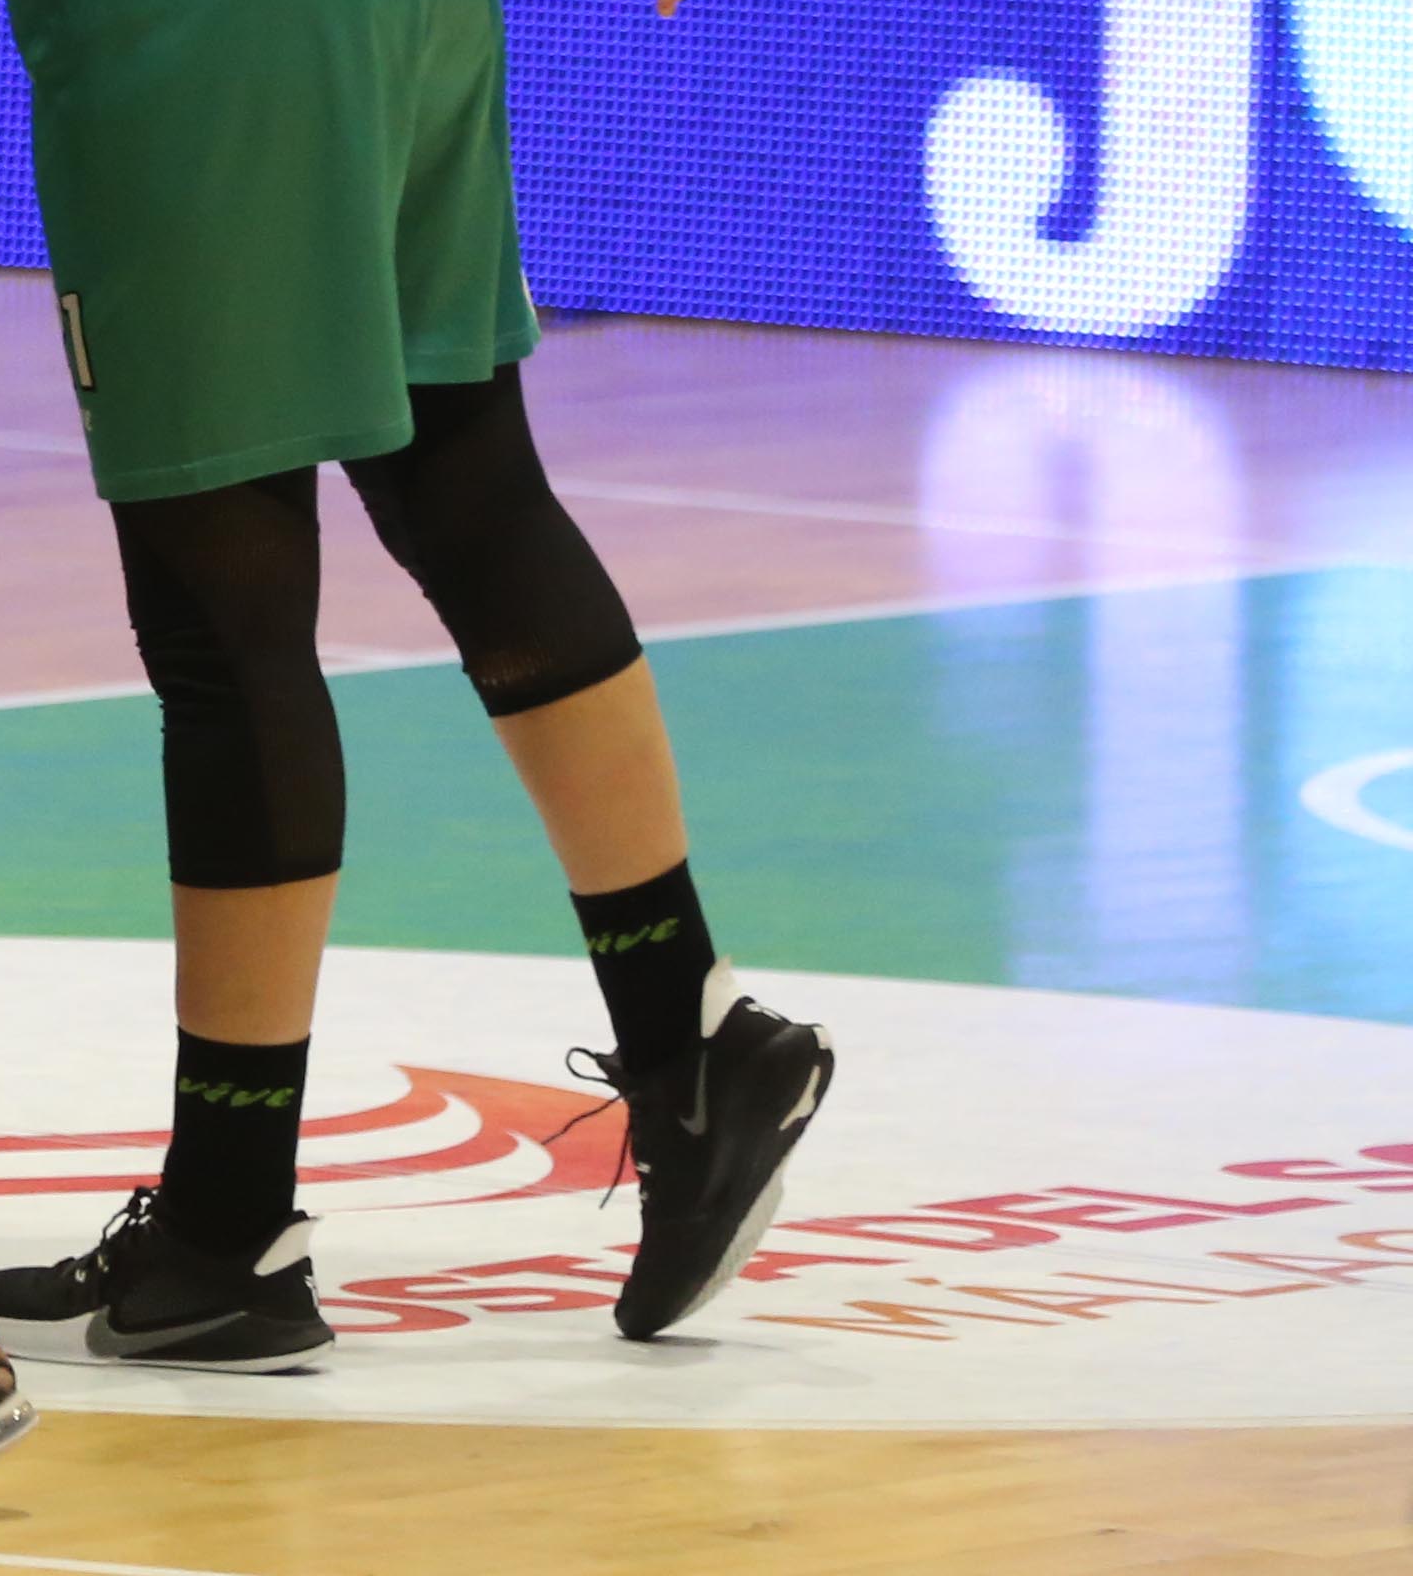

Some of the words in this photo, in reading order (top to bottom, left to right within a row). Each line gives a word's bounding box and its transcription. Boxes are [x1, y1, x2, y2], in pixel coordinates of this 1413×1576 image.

[177, 1076, 295, 1109] vive
[773, 1185, 1355, 1254] DEL
[1219, 1142, 1413, 1193] S
